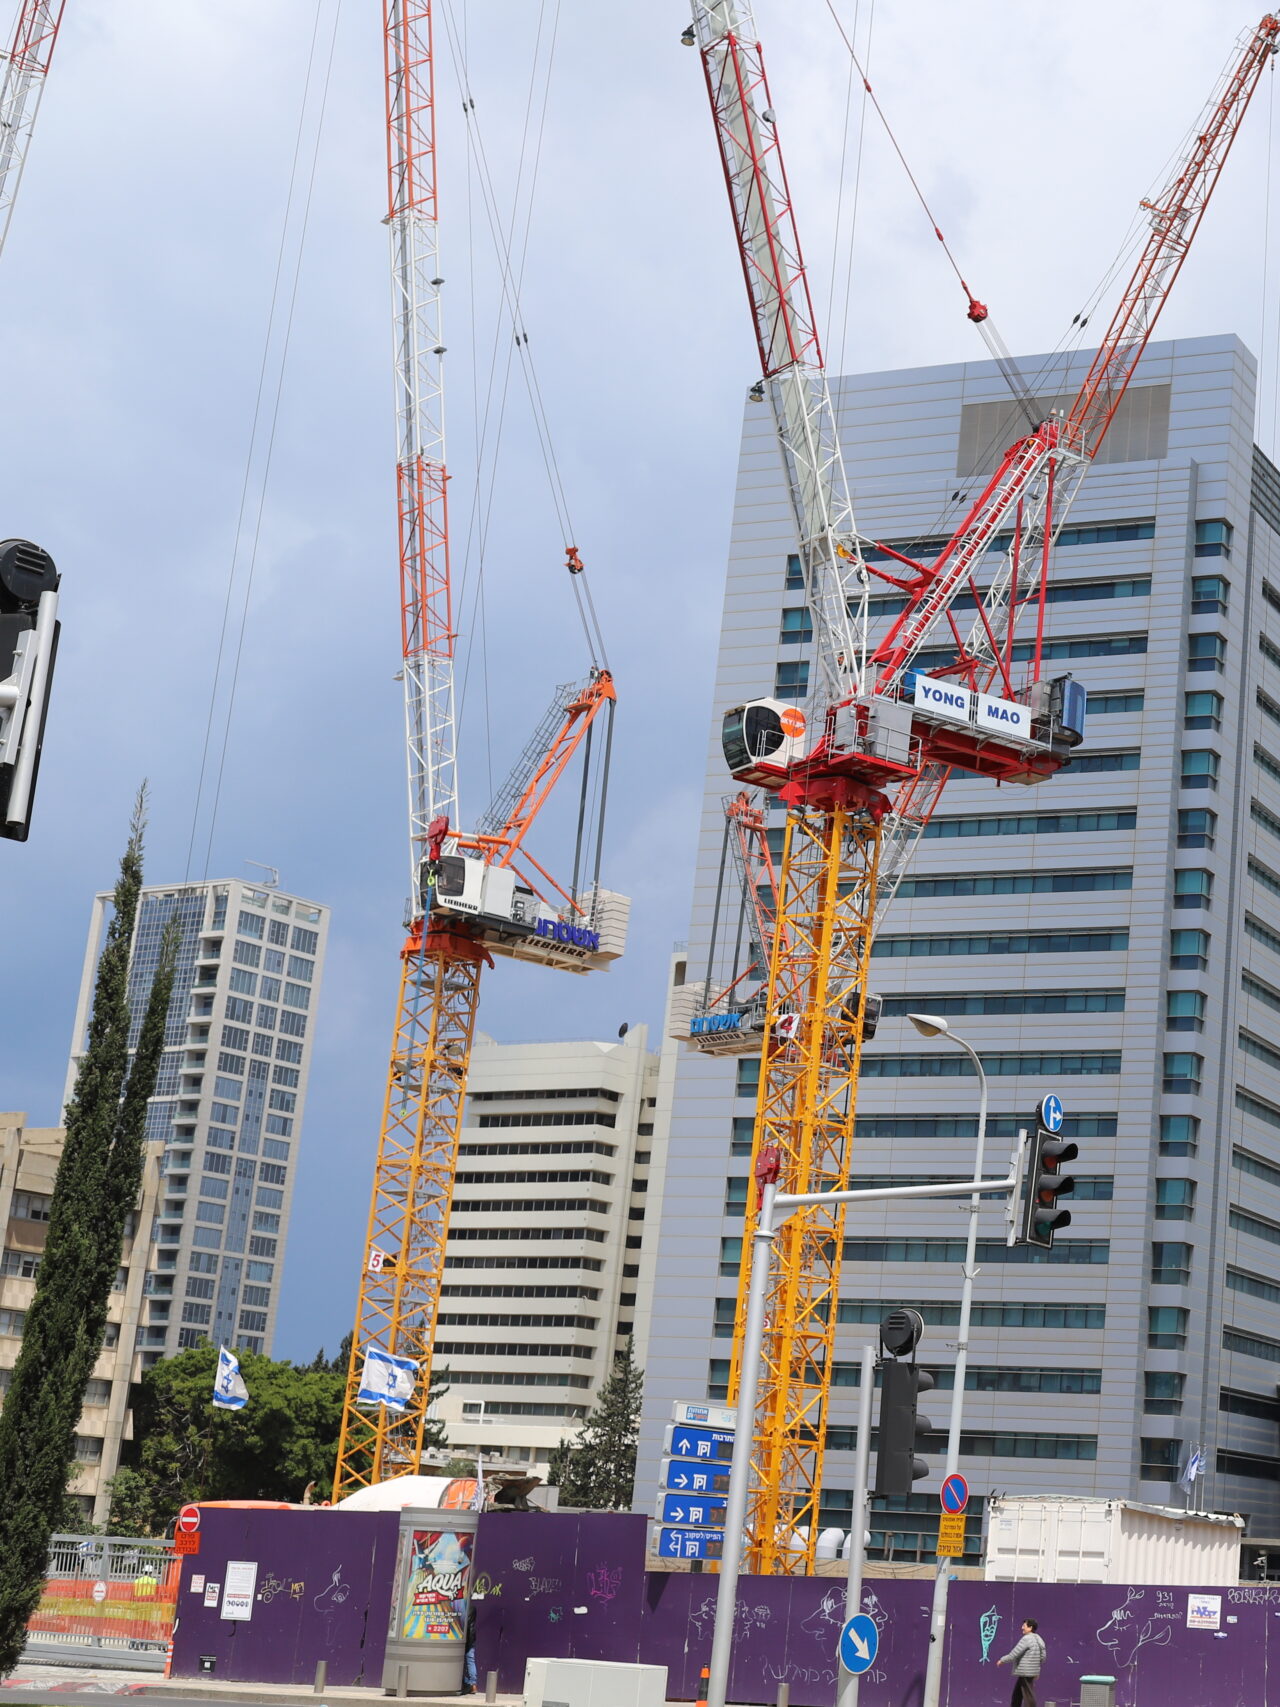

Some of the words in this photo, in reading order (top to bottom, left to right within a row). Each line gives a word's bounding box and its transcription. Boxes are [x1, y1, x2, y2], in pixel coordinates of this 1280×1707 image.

[920, 684, 966, 710] YONG
[986, 704, 1021, 725] MAO
[443, 897, 478, 912] LIEBHERR
[520, 936, 587, 959] LIEBHERR
[779, 1015, 794, 1032] 4
[696, 1032, 741, 1045] LIEBHERR
[371, 1253, 381, 1268] 5
[417, 1572, 462, 1598] AQUA
[1156, 1590, 1173, 1603] 931
